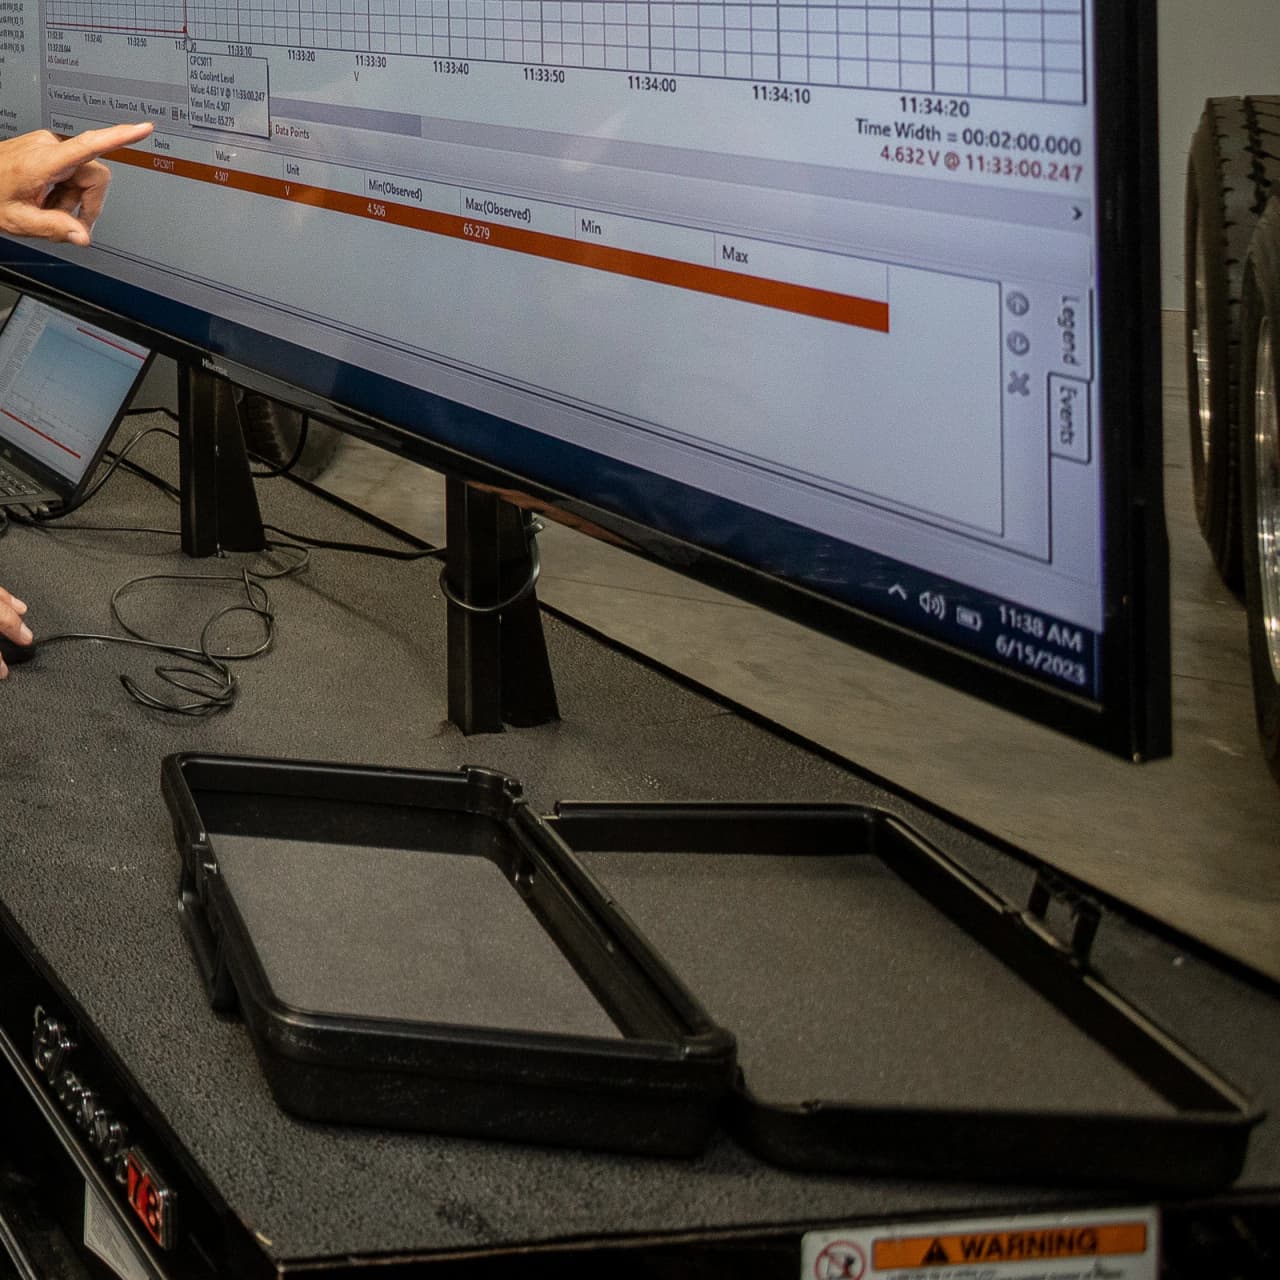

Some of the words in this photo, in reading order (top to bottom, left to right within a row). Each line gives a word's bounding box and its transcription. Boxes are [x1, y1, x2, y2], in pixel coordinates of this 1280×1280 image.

[84, 33, 102, 43] 11:32:40
[127, 36, 146, 47] 11:32:50
[227, 44, 252, 57] 11:33:10
[287, 48, 315, 62] 11:33:20
[189, 55, 212, 67] CPC501T
[355, 55, 387, 69] 11:33:30
[433, 61, 469, 76] 11:33:40
[199, 70, 219, 82] Coolant
[220, 72, 234, 84] Level
[353, 70, 359, 82] V
[523, 68, 565, 84] 11:33:50
[627, 75, 677, 93] 11:34:00
[53, 91, 62, 100] View
[63, 92, 80, 102] Selection
[88, 96, 100, 106] Zoom
[220, 87, 224, 98] V
[225, 88, 231, 99] @
[232, 88, 264, 103] 11:33:00.247
[751, 84, 811, 105] 11:34:10
[115, 100, 128, 110] Zoom
[128, 101, 137, 111] Out
[147, 104, 159, 114] View
[190, 97, 204, 109] View
[216, 101, 230, 113] 4.507
[899, 95, 971, 118] 11:34:20
[191, 111, 204, 123] View
[217, 115, 234, 128] 65.279
[275, 123, 288, 136] Data
[289, 125, 309, 139] Points
[855, 118, 891, 138] Time
[895, 121, 941, 143] Width
[962, 127, 1082, 156] 00:02:00.000
[154, 138, 169, 150] Device
[215, 150, 230, 163] Value
[880, 145, 925, 166] 4.632
[928, 149, 940, 166] V
[943, 151, 961, 171] @
[966, 154, 1083, 182] 11:33:00.247
[214, 170, 228, 184] 4.507
[286, 162, 299, 176] Unit
[285, 184, 290, 196] V
[368, 178, 423, 202] Min(Observed)
[367, 203, 386, 217] 4.506
[465, 196, 532, 223] Max(Observed)
[462, 222, 490, 240] 65.279
[581, 218, 602, 235] Min
[721, 244, 749, 264] Max
[1057, 294, 1080, 367] Legend
[1058, 386, 1078, 447] Events
[999, 604, 1045, 635] 11:38
[1047, 622, 1083, 653] AM
[996, 634, 1086, 685] 6/15/2023
[960, 1228, 1099, 1260] WARNING
